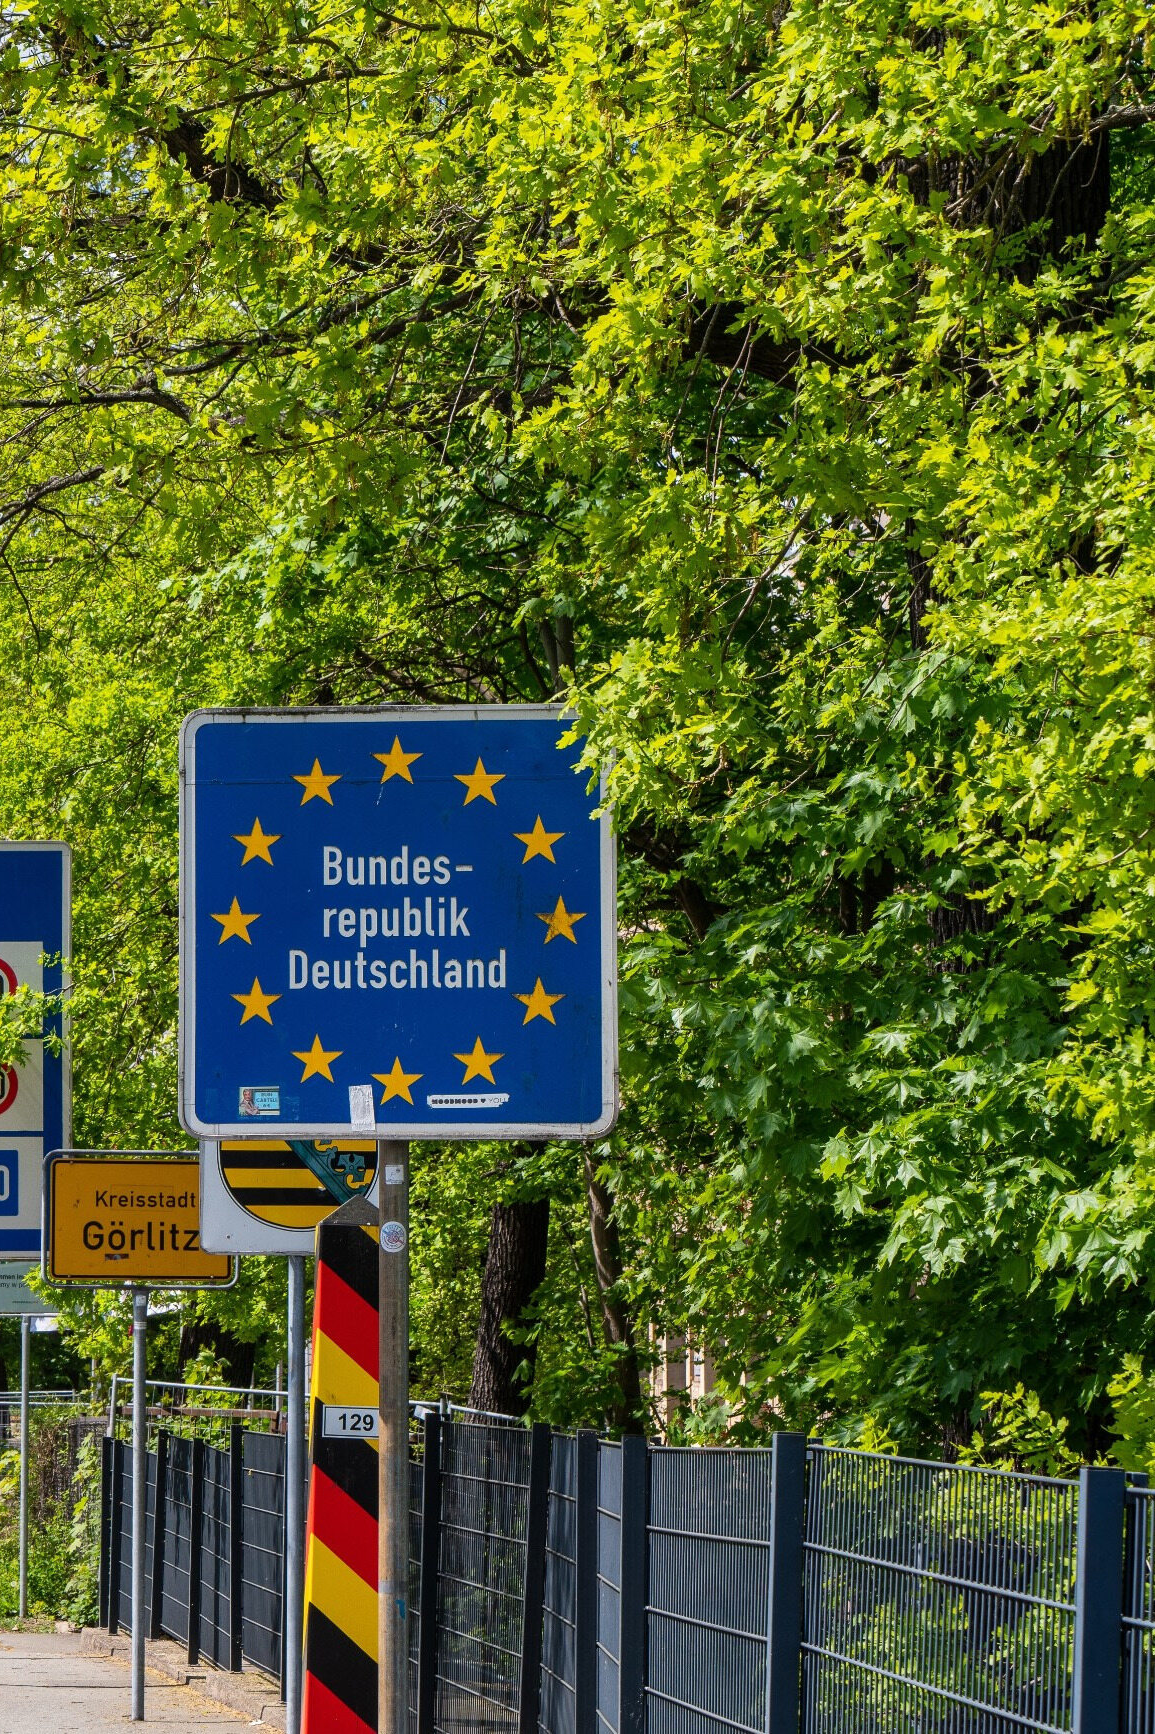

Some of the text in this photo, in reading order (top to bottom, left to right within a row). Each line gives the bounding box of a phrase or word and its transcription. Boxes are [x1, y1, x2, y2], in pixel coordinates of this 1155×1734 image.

[323, 845, 473, 886] Bundes-
[323, 897, 471, 947] republik
[288, 948, 507, 990] Deutschland
[95, 1190, 196, 1208] Kreisstadt
[82, 1220, 200, 1251] Görlitz
[338, 1413, 374, 1431] 129
